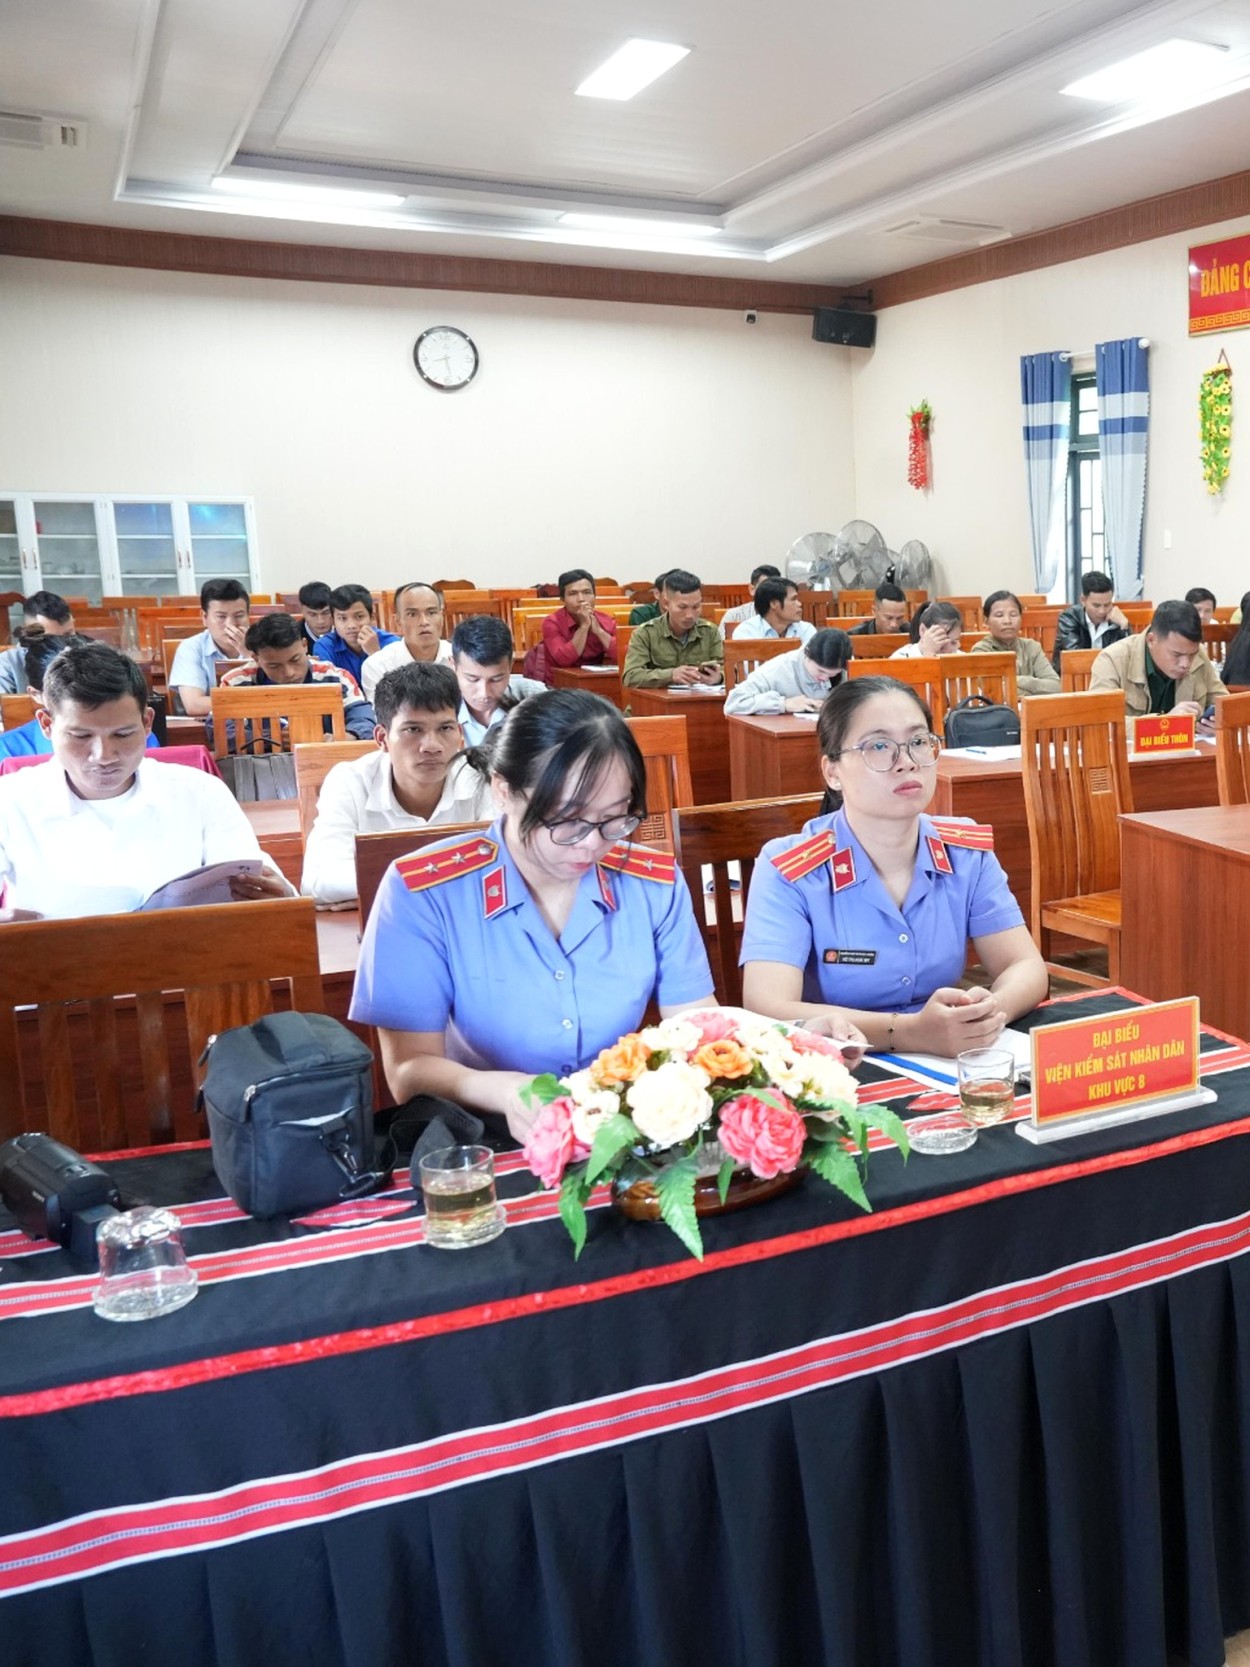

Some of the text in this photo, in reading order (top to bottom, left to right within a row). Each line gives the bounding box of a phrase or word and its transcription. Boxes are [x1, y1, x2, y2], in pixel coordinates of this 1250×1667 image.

[1200, 258, 1240, 297] ĐẢNG
[1093, 1030, 1112, 1050] ĐẠI
[1045, 1040, 1185, 1085] VIỆN KIỂM SÁT NHÂN DÂN
[1088, 1075, 1146, 1100] KHU VỰC 8
